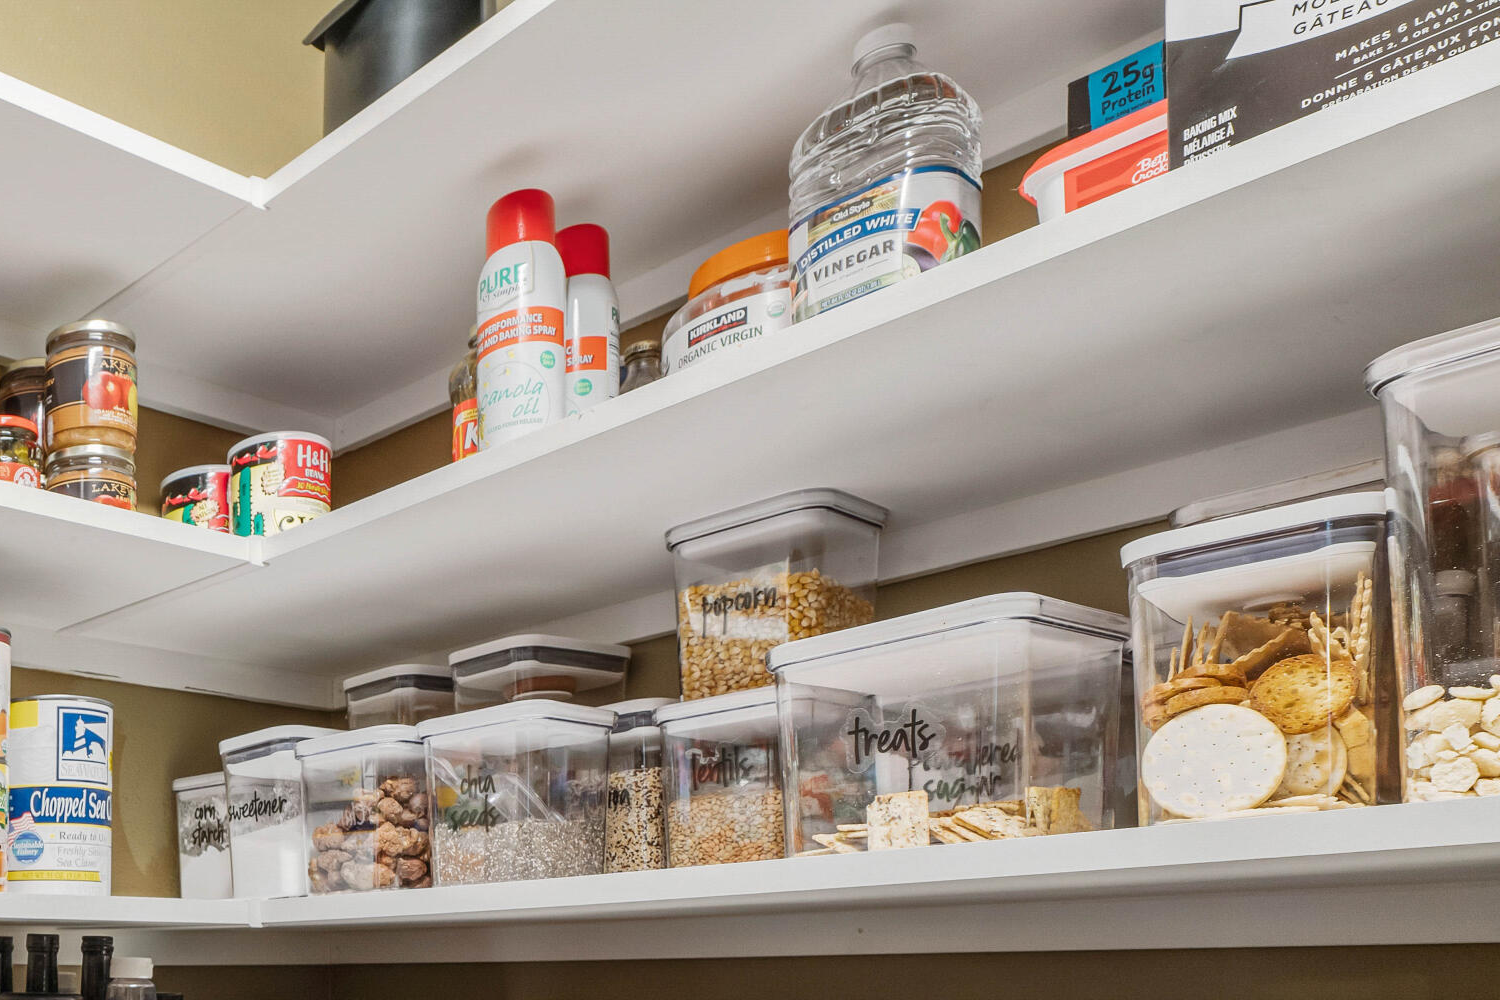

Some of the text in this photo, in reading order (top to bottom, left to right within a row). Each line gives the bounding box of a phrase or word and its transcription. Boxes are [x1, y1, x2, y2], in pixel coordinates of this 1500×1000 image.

[1335, 0, 1458, 61] MAKES 6 LAVA
[1353, 12, 1461, 64] BAKE OR AT
[1101, 60, 1155, 98] 25g
[1301, 33, 1462, 109] DONNE GÂTEAUX
[1101, 80, 1156, 115] Protein
[1183, 106, 1238, 142] BAKING MIX
[1183, 130, 1226, 157] MÉLANGE
[833, 200, 871, 221] Old Style
[800, 211, 915, 270] DISTILLED WHITE
[813, 238, 896, 283] VINEGAR
[484, 313, 543, 338] PERFORMANCE
[484, 324, 557, 348] AND BAKING SPRAY
[688, 308, 747, 343] KIRKLAND
[678, 324, 763, 368] ORGANIC VIRGIN
[297, 444, 331, 474] H&H
[702, 587, 777, 639] popcorn
[847, 708, 936, 765] treats
[460, 764, 496, 797] chia
[30, 788, 106, 823] Chopped Sea
[194, 803, 216, 821] corn
[228, 790, 287, 823] sweetener
[449, 795, 499, 832] seeds
[59, 831, 87, 841] Ready
[191, 822, 227, 845] starch
